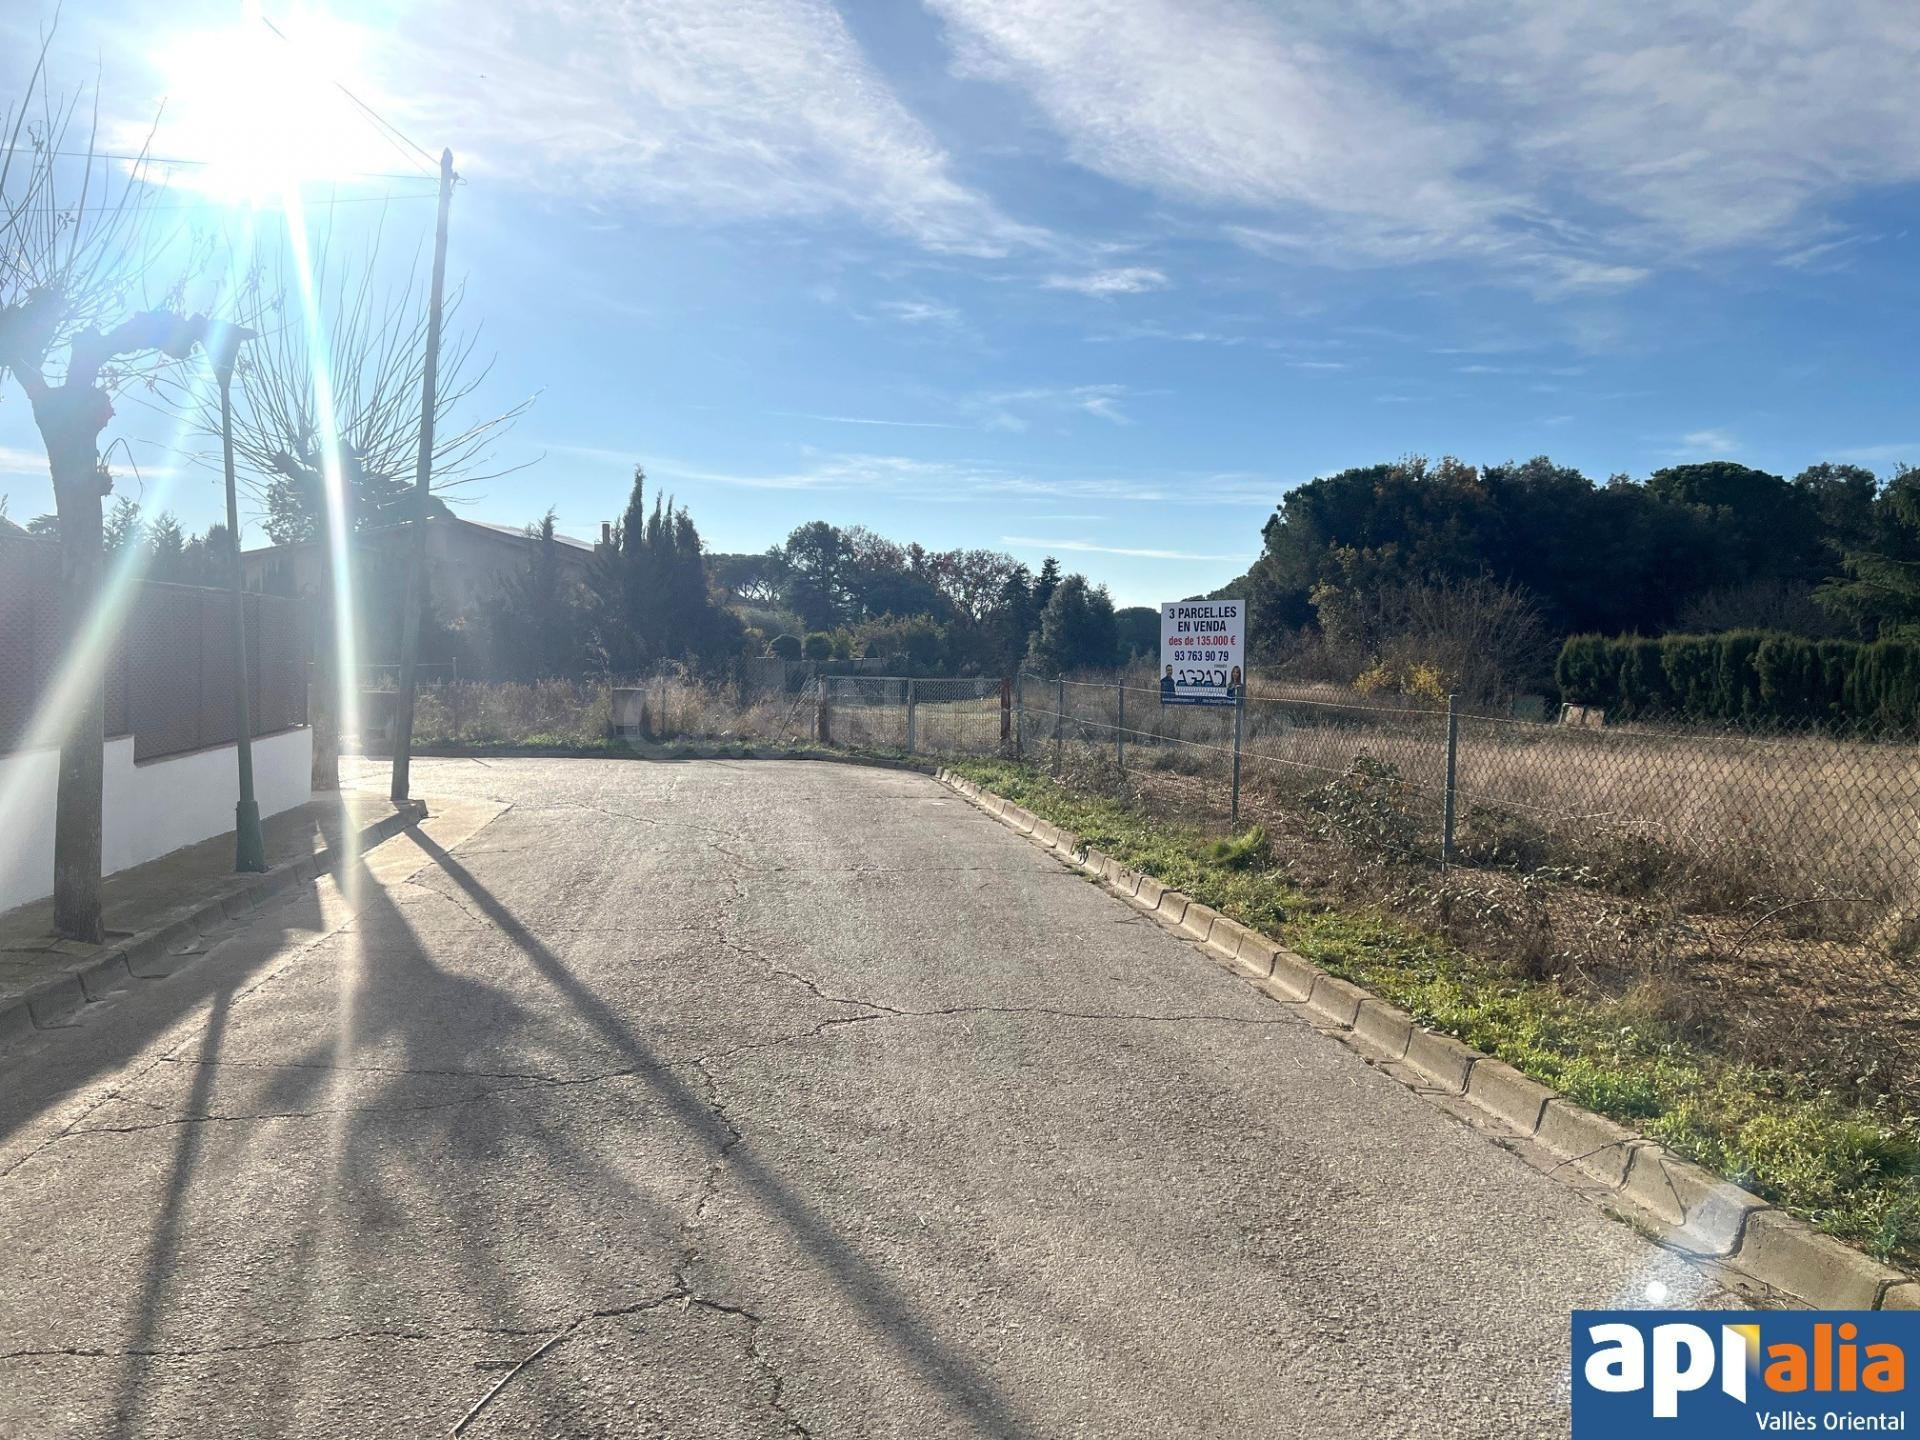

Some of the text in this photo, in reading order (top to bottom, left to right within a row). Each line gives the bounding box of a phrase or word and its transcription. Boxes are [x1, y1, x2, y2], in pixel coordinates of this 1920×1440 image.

[1169, 606, 1237, 619] 3 PARCEL.LES
[1177, 620, 1227, 632] EN VENDA
[1168, 635, 1236, 646] des de 135.000 €
[1174, 650, 1229, 661] 93 763 90 79
